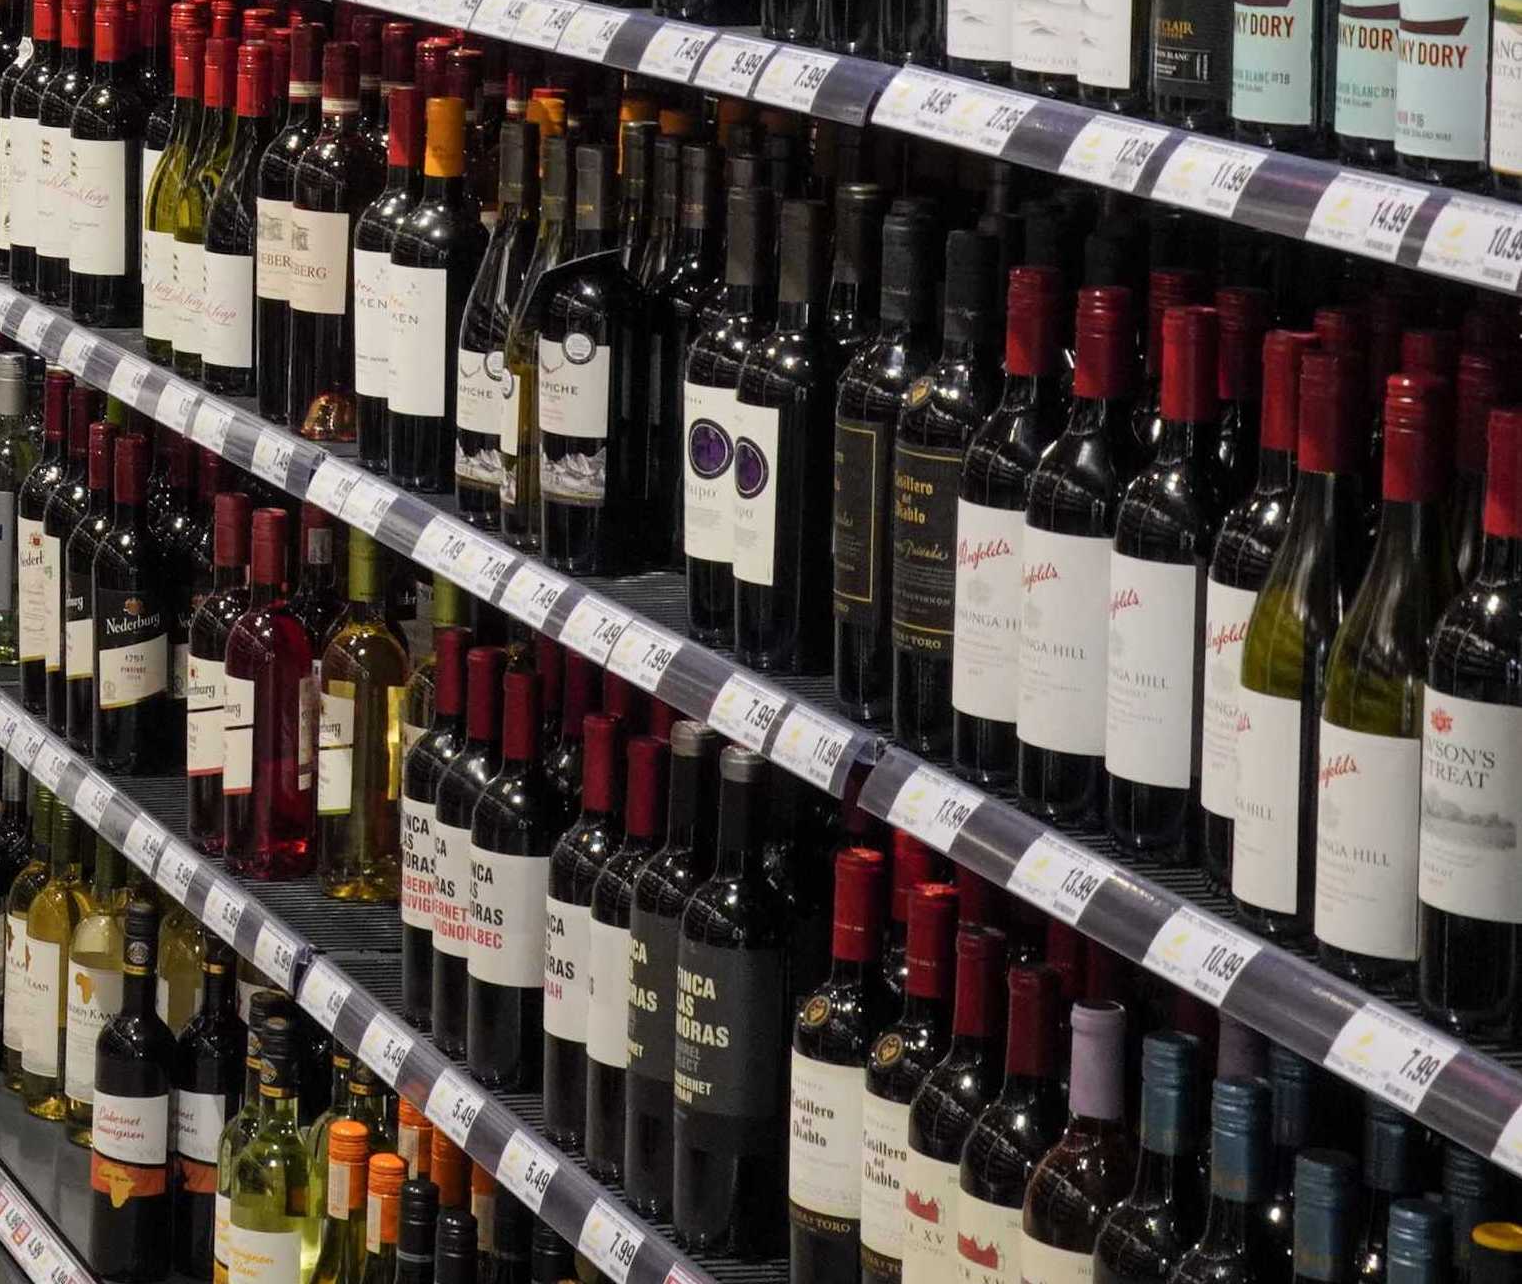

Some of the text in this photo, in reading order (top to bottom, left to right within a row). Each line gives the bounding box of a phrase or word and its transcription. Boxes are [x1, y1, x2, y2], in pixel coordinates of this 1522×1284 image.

[1249, 13, 1295, 39] DORY
[730, 50, 762, 77] 9.99
[1417, 45, 1469, 69] DORY
[794, 63, 825, 91] 7.99
[1210, 161, 1250, 193] 11.99
[1369, 199, 1411, 234] 14.99
[440, 534, 466, 562] 7.49
[480, 554, 507, 583] 7.49
[530, 580, 558, 610] 7.49
[106, 612, 161, 638] Nederburg
[593, 615, 620, 645] 7.49
[911, 636, 942, 650] TORO
[1053, 644, 1087, 662] HILL
[643, 644, 670, 672] 7.99
[1134, 673, 1170, 691] HILL
[750, 700, 777, 730] 7.99
[811, 735, 843, 767] 11.99
[939, 798, 972, 829] 13.99
[1353, 849, 1391, 868] HILL
[1060, 866, 1098, 903] 13.99
[272, 944, 294, 973] 5.99
[1203, 946, 1245, 982] 10.99
[382, 1040, 408, 1070] 5.49
[1399, 1049, 1441, 1083] 7.99
[451, 1096, 479, 1128] 5.49
[792, 1120, 828, 1149] Diablo
[524, 1160, 552, 1194] 5.49
[864, 1162, 901, 1191] Diablo
[608, 1231, 637, 1268] 7.99
